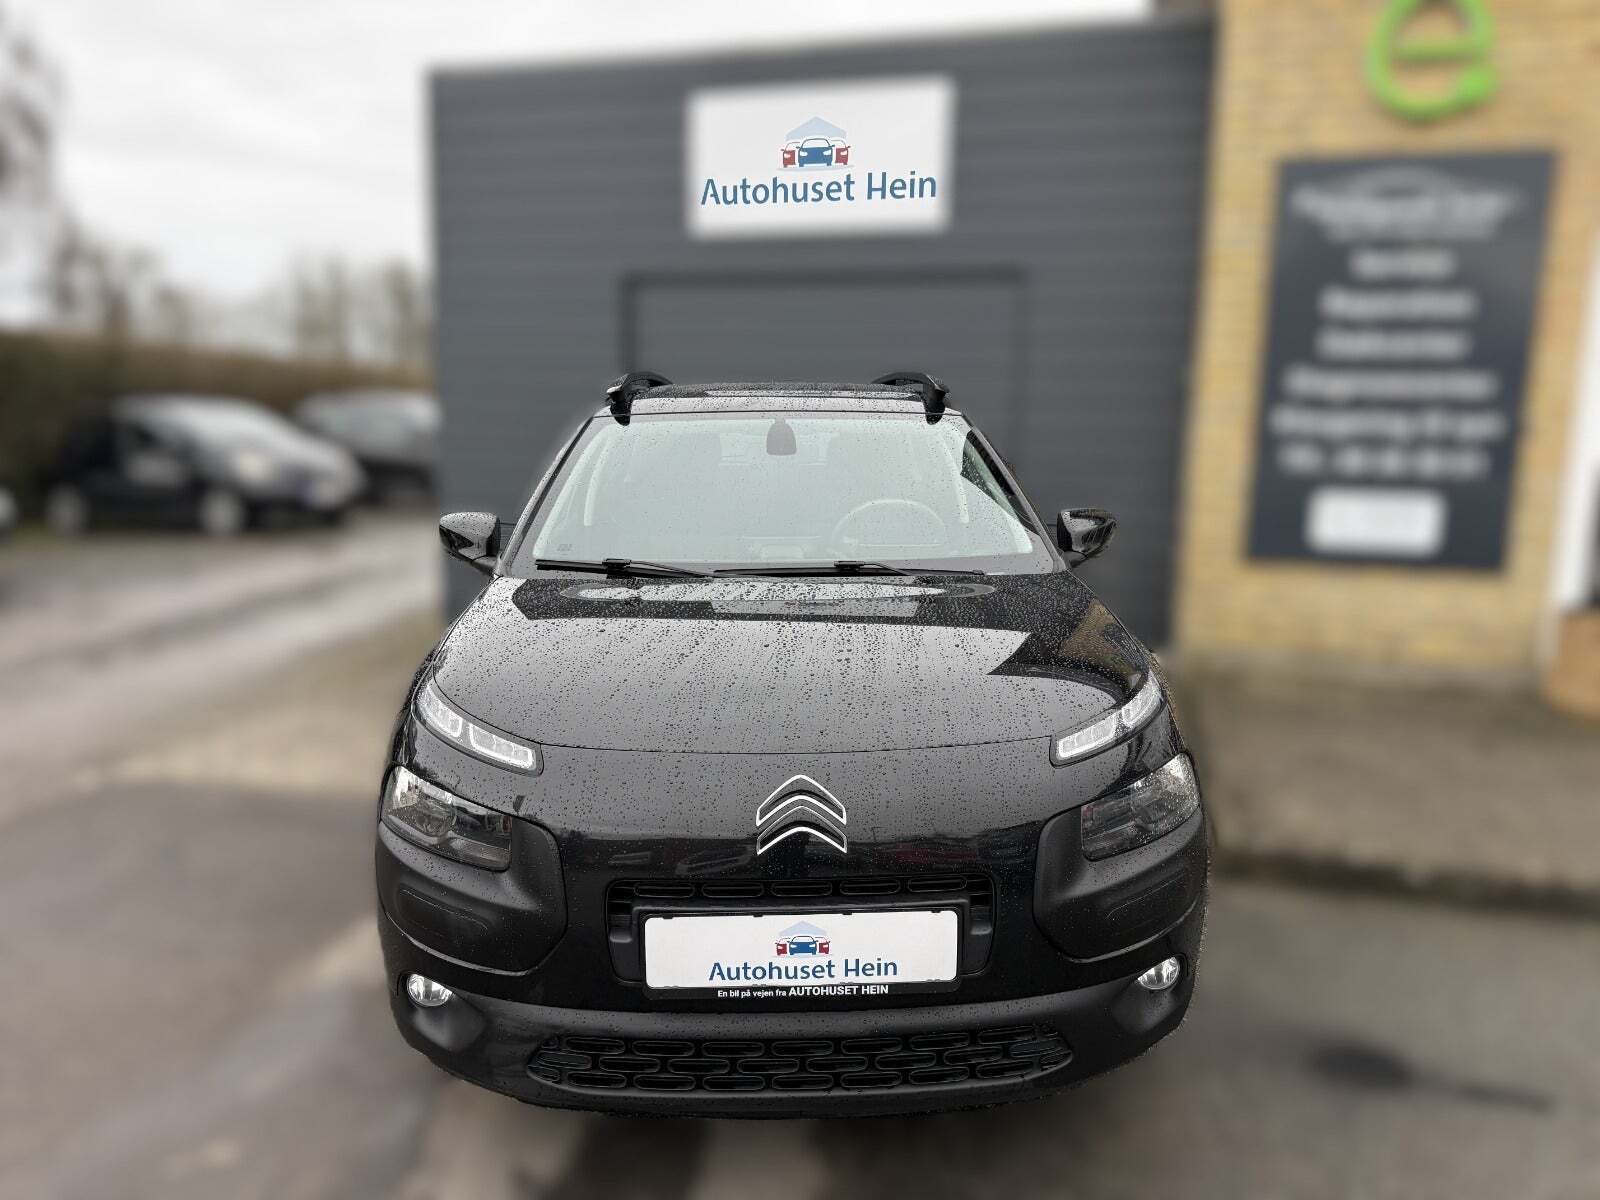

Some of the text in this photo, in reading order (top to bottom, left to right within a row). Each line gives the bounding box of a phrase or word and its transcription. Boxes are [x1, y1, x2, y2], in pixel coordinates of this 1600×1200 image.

[701, 171, 937, 205] Autohuset Hein
[708, 957, 898, 981] Autohuset Hein
[717, 984, 889, 999] En bil på vejen fra AUTOHUSET HEIN
